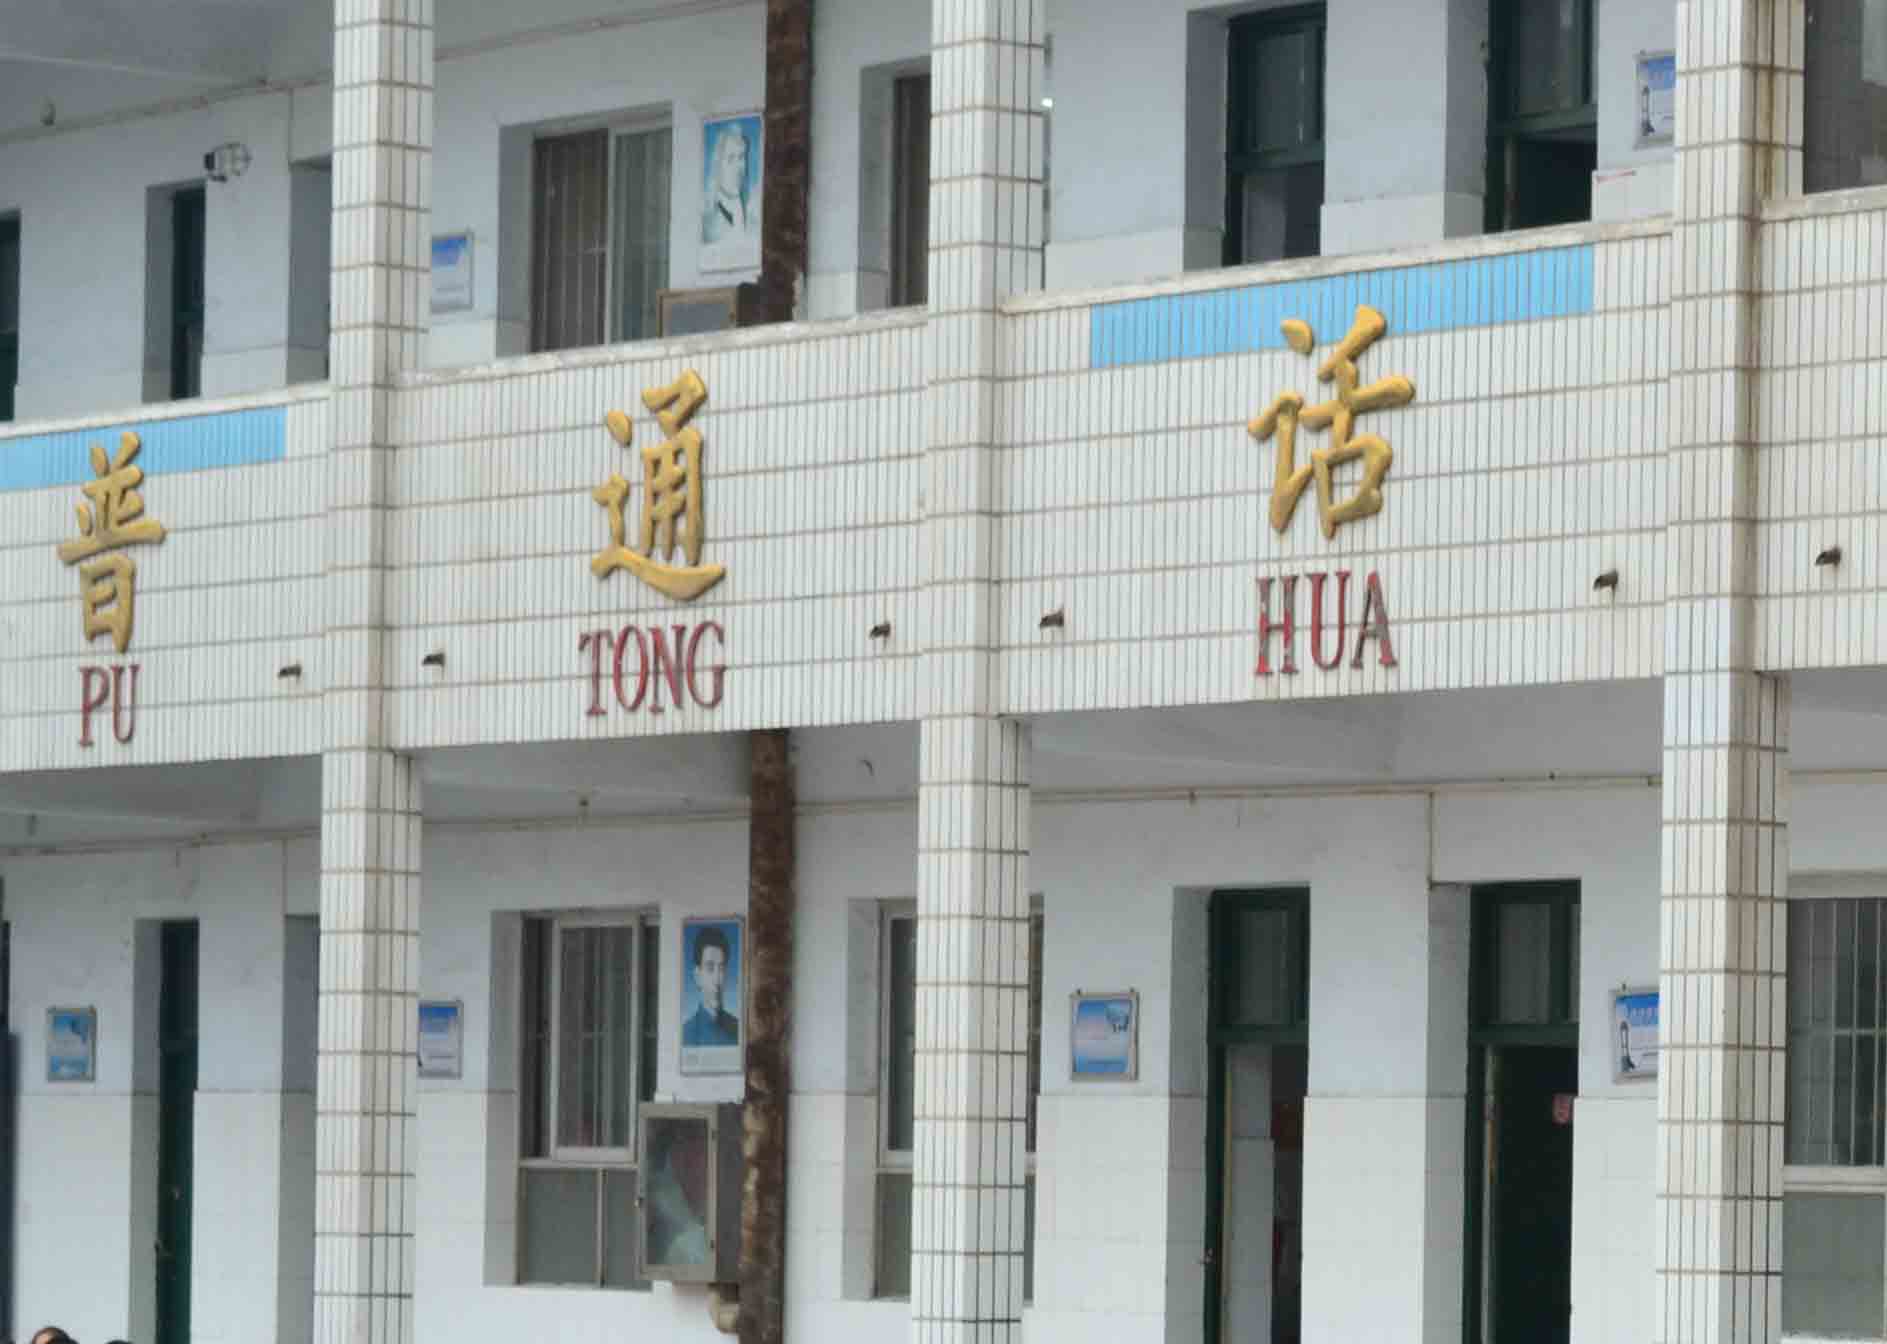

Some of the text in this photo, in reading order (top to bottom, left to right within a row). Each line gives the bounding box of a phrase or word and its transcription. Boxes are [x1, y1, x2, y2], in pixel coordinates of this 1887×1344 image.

[590, 368, 727, 601] 通
[1246, 304, 1416, 540] 话
[56, 430, 167, 654] 普
[1254, 567, 1399, 677] HUA
[78, 664, 141, 748] PU
[578, 619, 727, 717] TONG
